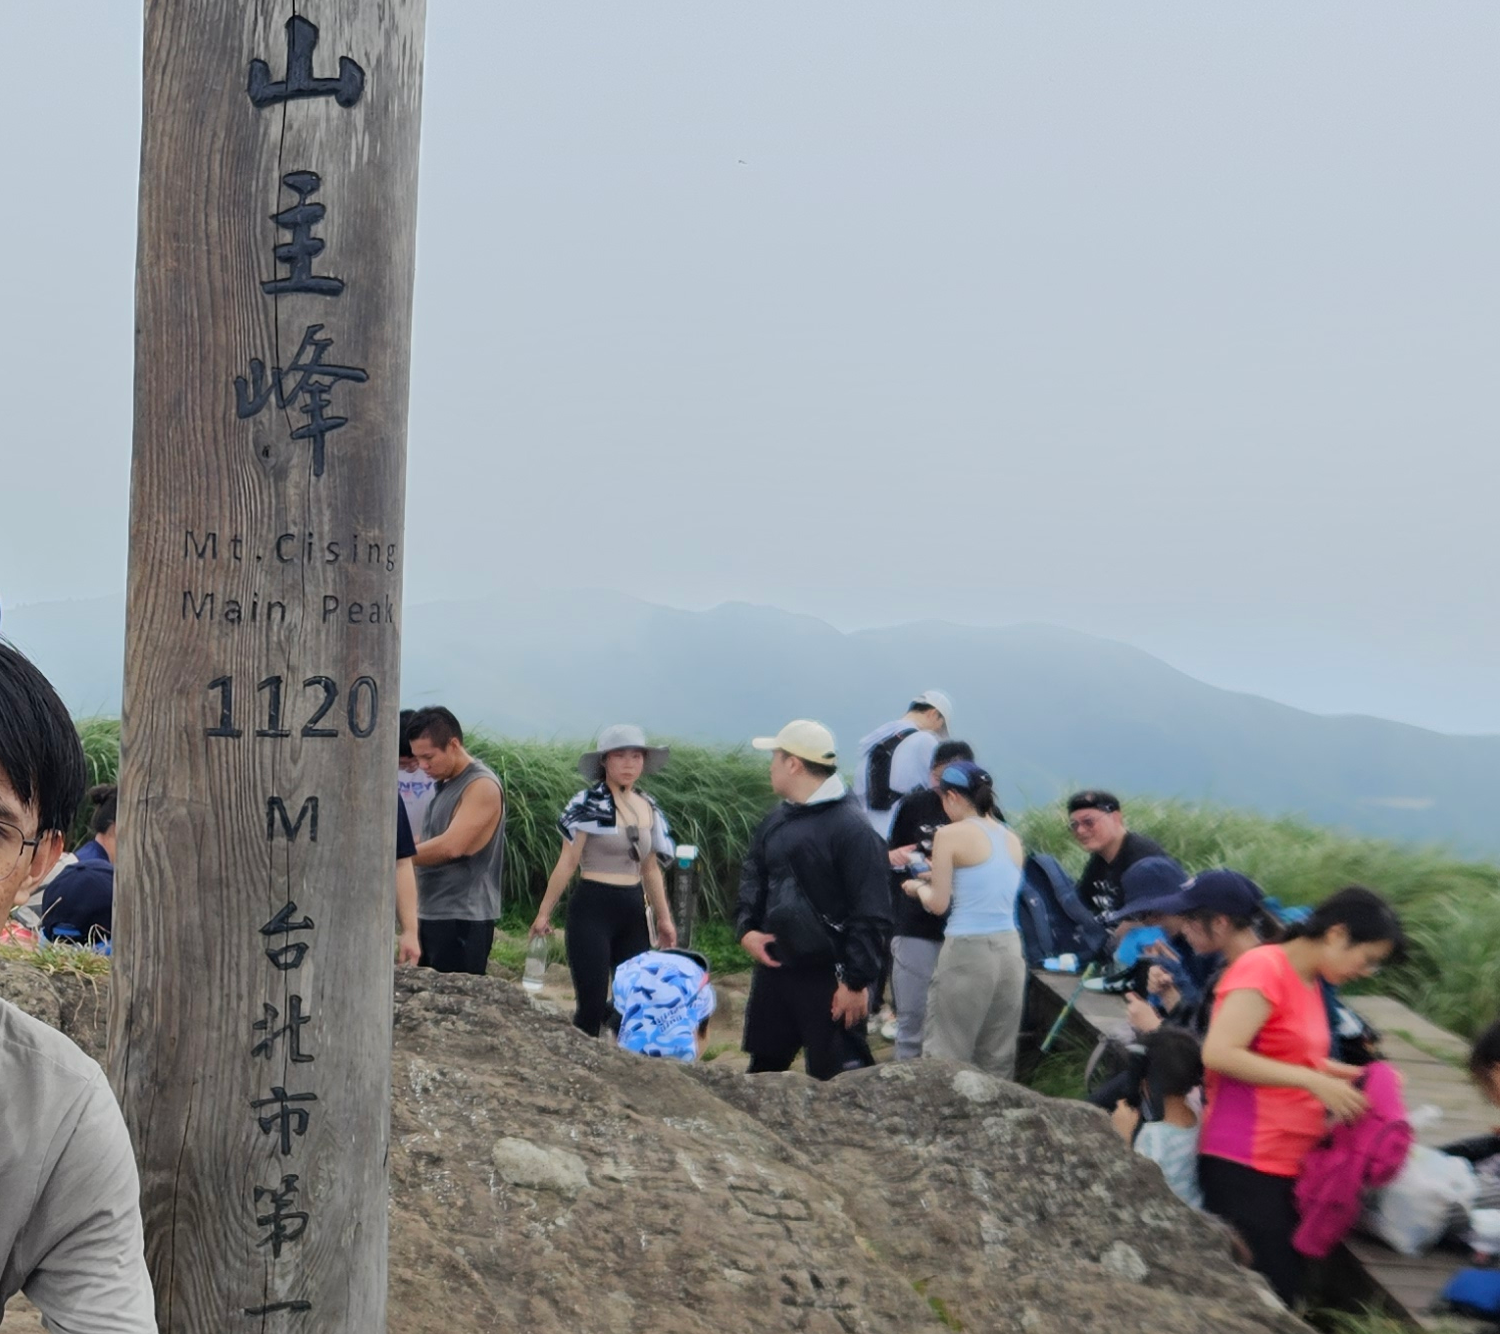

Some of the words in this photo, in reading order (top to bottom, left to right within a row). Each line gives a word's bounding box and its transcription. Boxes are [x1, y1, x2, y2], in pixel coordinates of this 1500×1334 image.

[181, 590, 287, 624] Main
[322, 594, 394, 625] Peak
[205, 675, 380, 739] 1120
